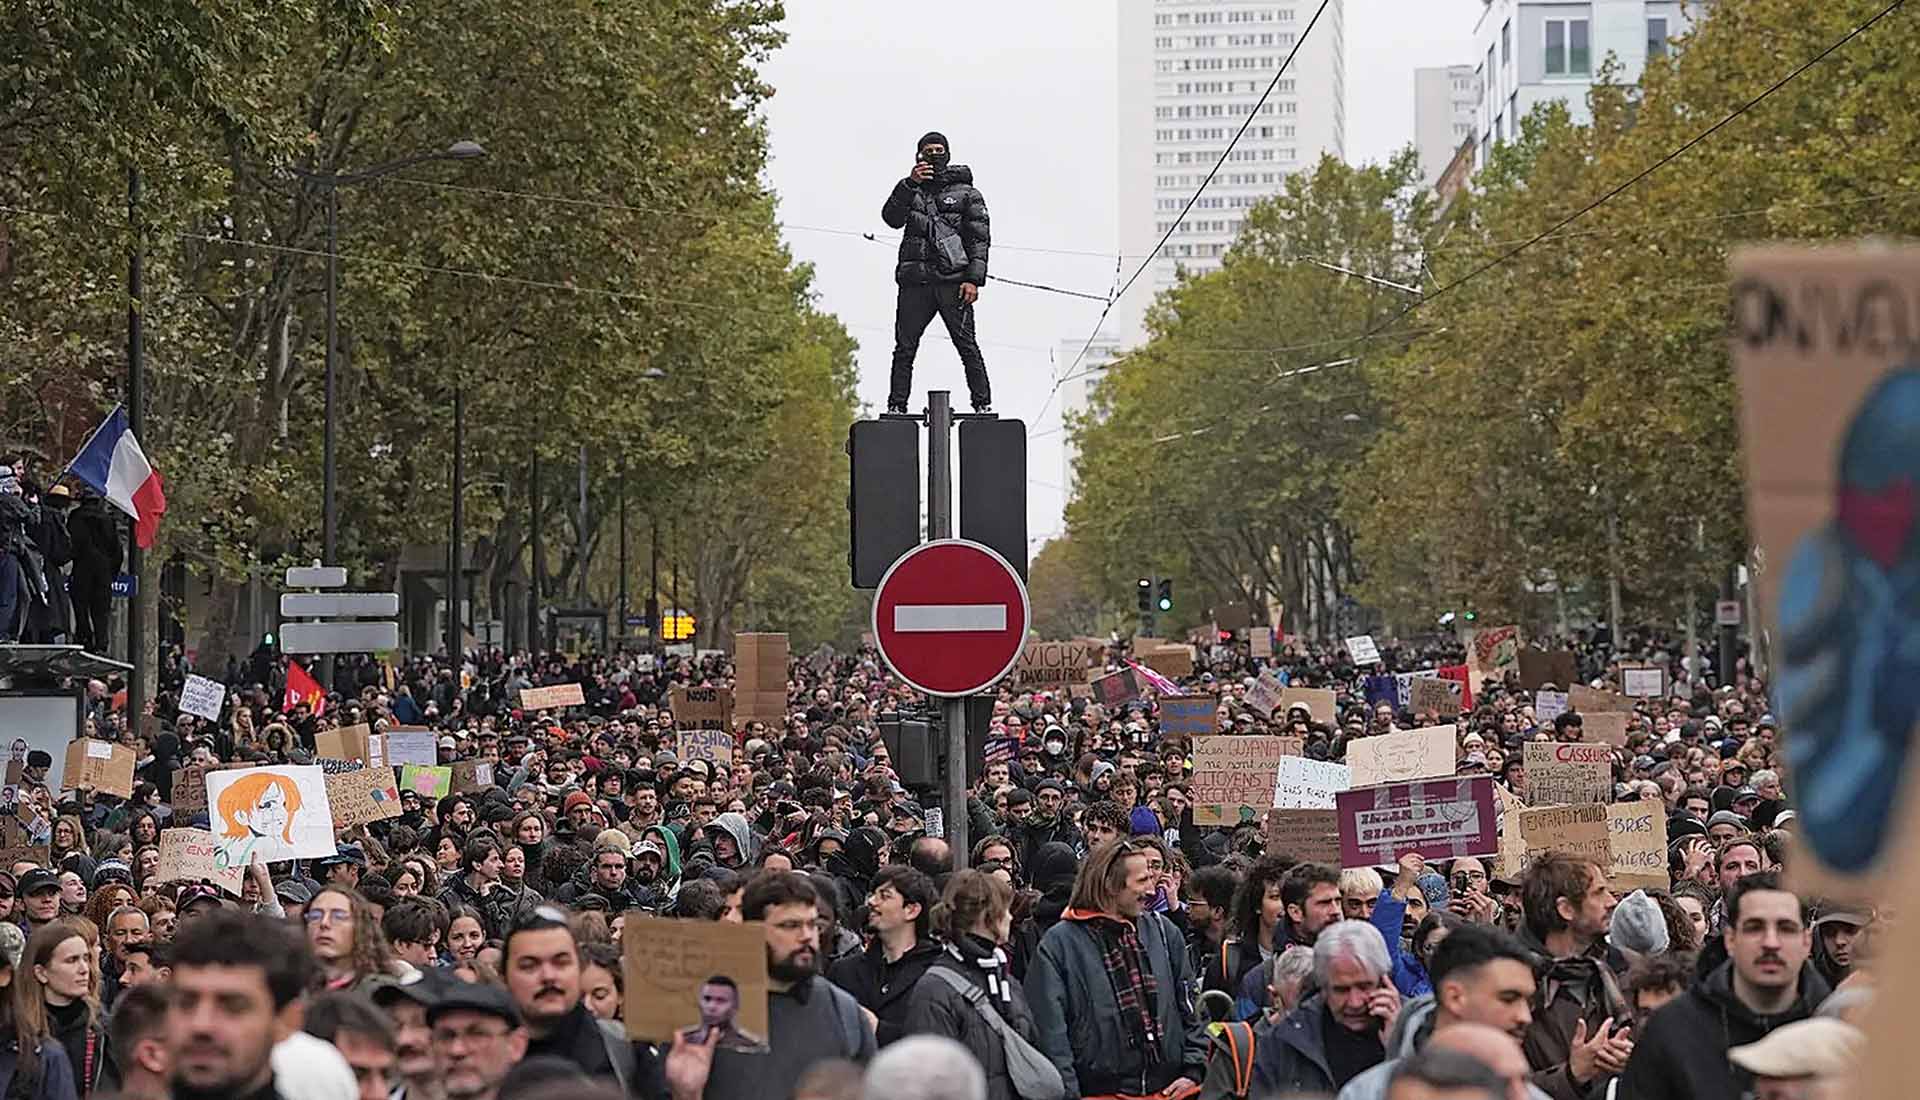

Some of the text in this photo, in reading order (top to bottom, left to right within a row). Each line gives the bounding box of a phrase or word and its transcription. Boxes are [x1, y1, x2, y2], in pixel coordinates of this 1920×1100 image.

[1023, 645, 1086, 667] VICHY
[686, 689, 717, 703] NOUS
[686, 745, 714, 758] PAS
[1525, 744, 1612, 763] VRAIS CASSEURS
[1193, 771, 1262, 788] CITOYENS
[1193, 787, 1248, 804] SECONDE
[1256, 788, 1275, 804] ZO
